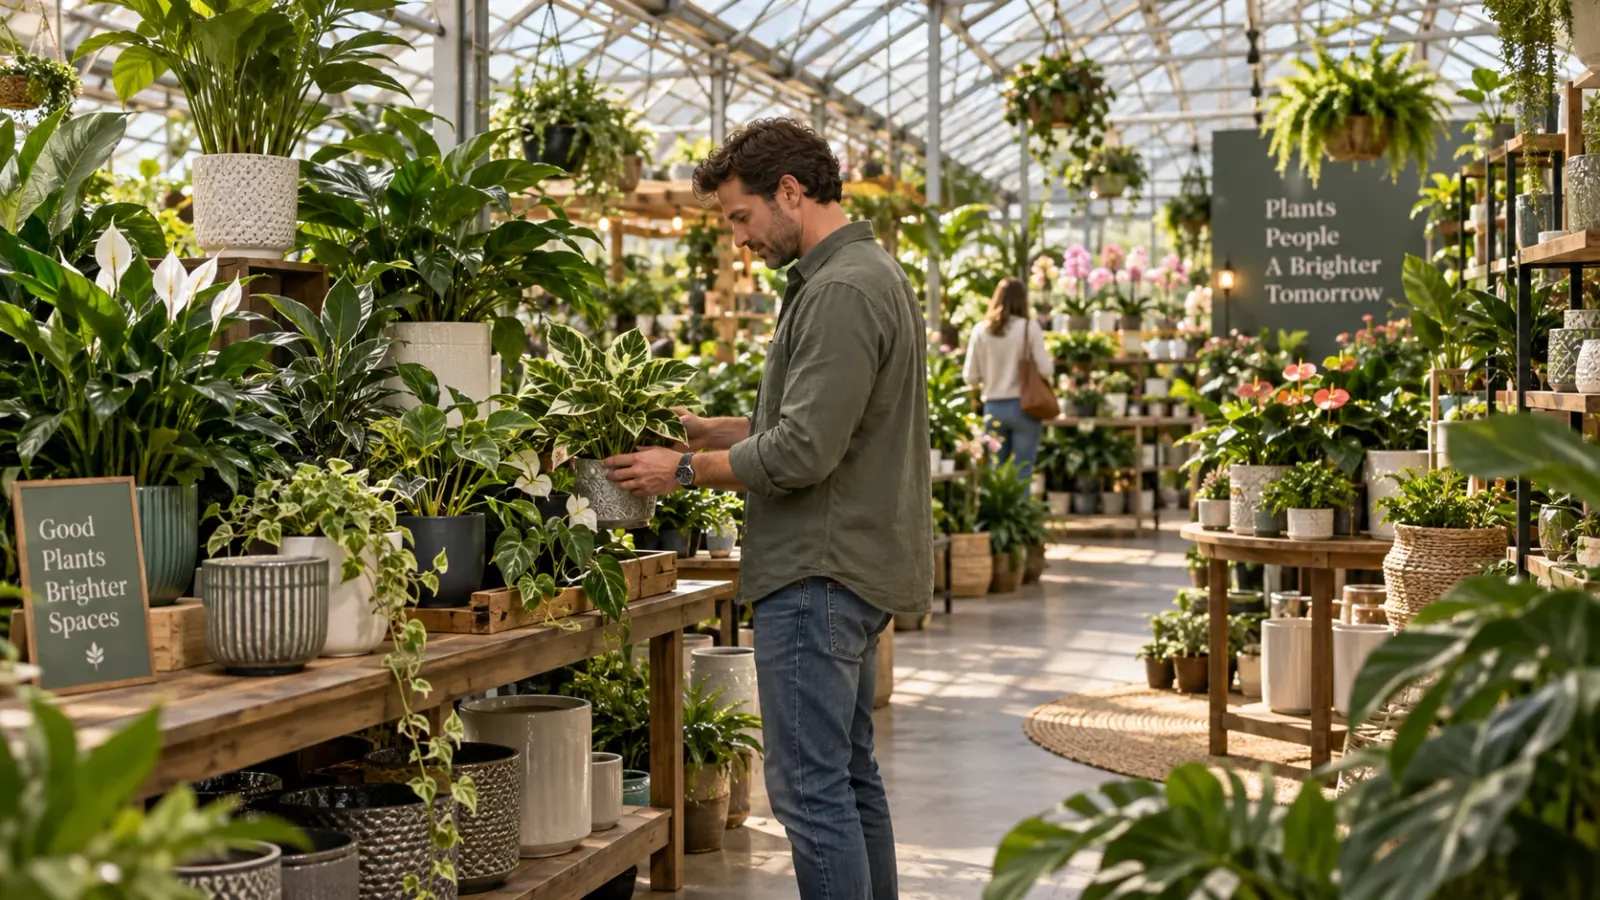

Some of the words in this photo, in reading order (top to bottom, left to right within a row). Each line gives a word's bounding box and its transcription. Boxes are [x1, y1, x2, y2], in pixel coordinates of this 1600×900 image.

[1265, 198, 1337, 219] Plants
[1265, 225, 1340, 252] People
[1265, 257, 1283, 277] A
[1290, 254, 1382, 280] Brighter
[1264, 284, 1383, 304] Tomorrow
[39, 515, 95, 540] Good
[42, 548, 106, 571] Plants
[45, 577, 128, 606] Brighter
[49, 611, 120, 639] Spaces
